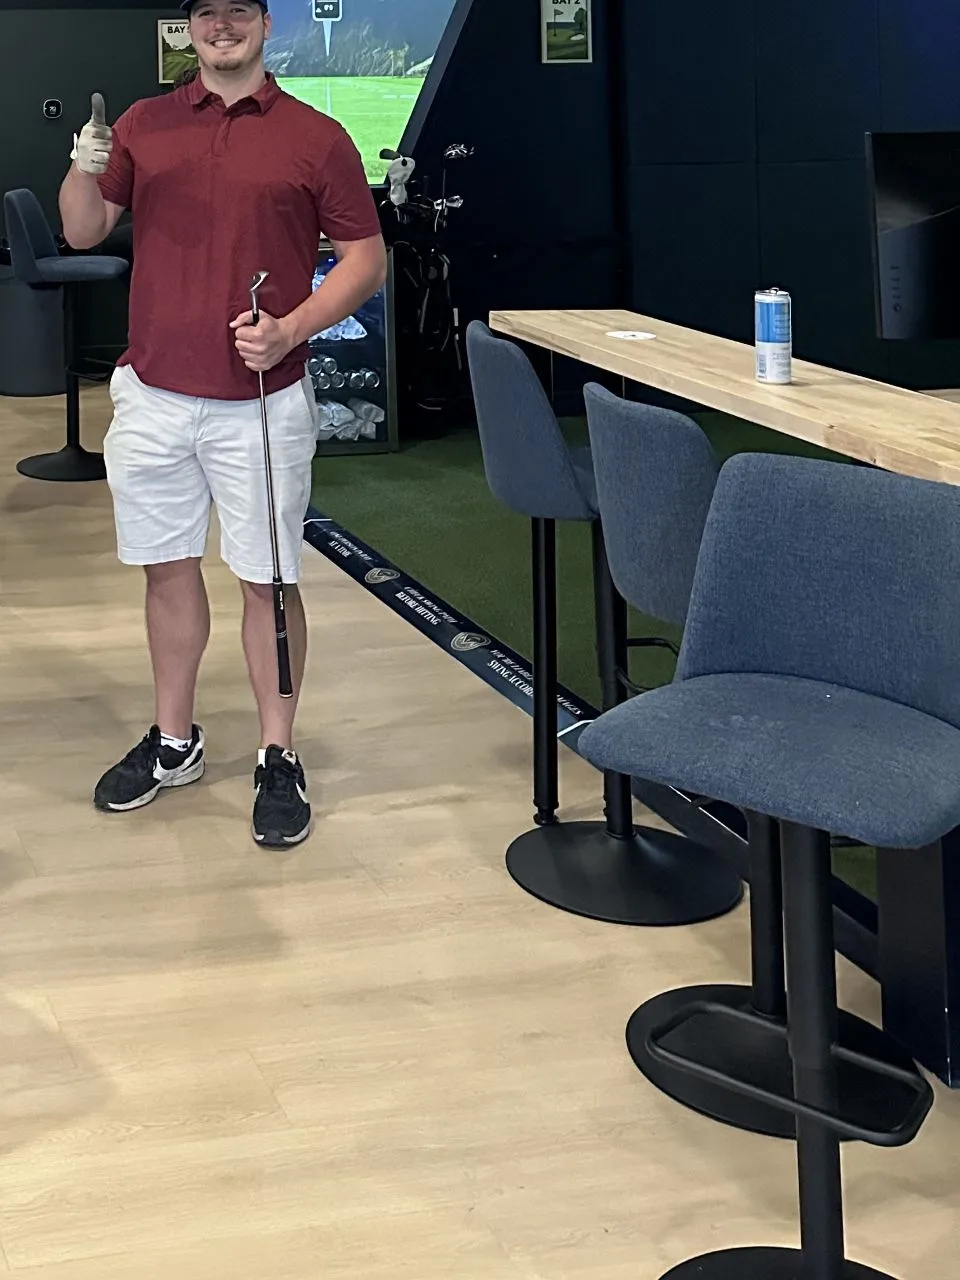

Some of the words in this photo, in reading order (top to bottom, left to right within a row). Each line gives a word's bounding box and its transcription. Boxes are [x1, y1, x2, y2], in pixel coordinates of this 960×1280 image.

[167, 25, 186, 34] BAY
[415, 604, 442, 626] HITTING
[487, 660, 511, 680] SWING
